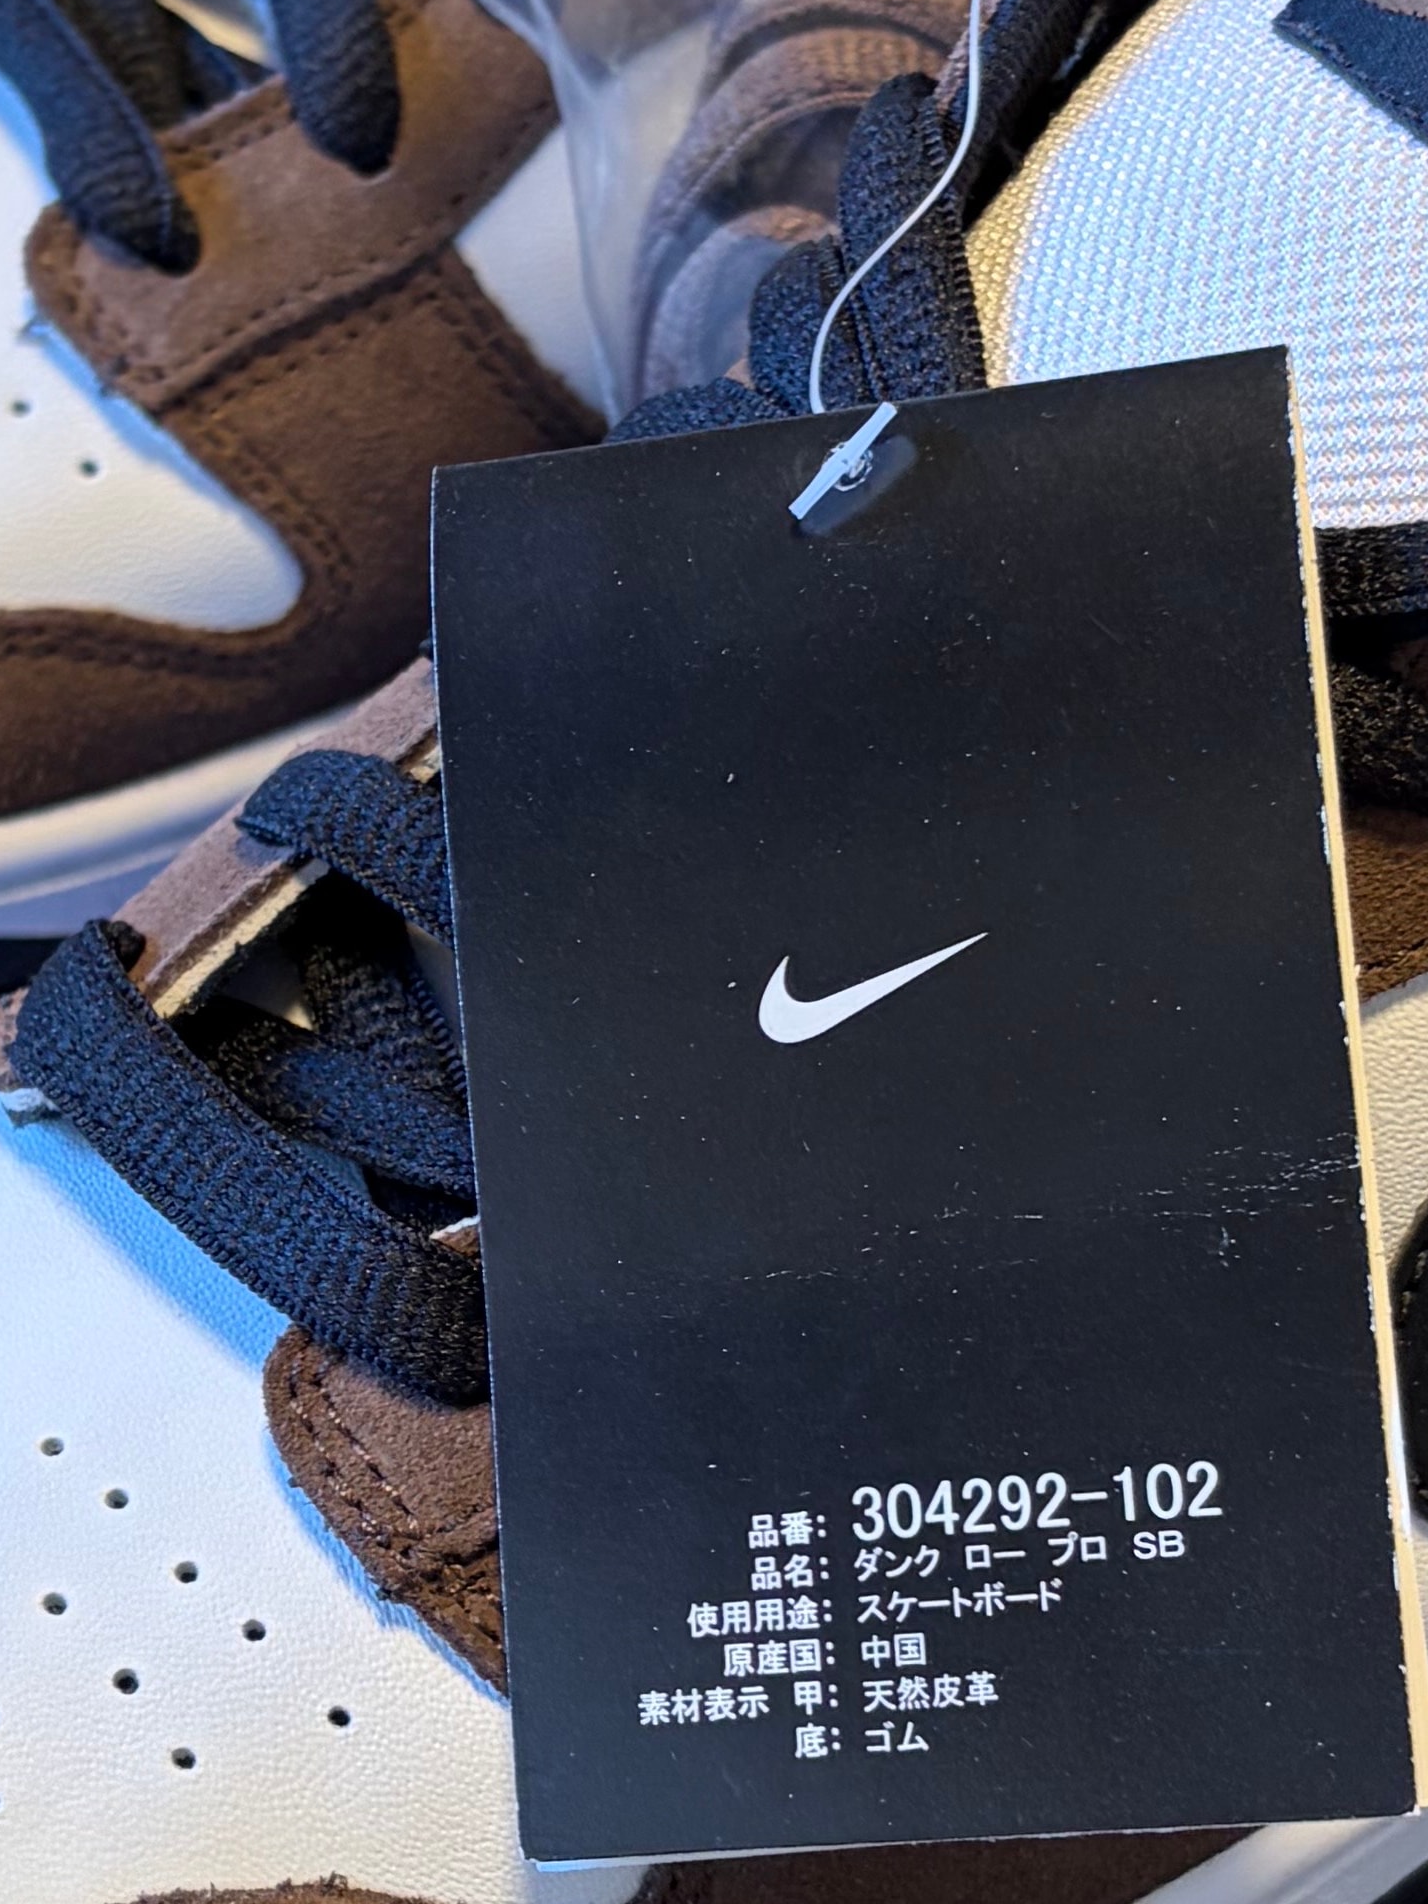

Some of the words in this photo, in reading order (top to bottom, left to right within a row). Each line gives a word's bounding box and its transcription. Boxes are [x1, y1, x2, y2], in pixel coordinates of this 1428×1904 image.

[851, 1460, 1224, 1542] 304292-102
[853, 1546, 941, 1582] ダンク
[964, 1543, 1027, 1571] ロー
[1047, 1530, 1108, 1567] プロ
[1133, 1529, 1186, 1560] SB
[856, 1577, 1063, 1624] スケートボード
[860, 1632, 927, 1669] 中国
[637, 1685, 771, 1726] 素材表示
[862, 1670, 1000, 1713] 天然皮革
[864, 1720, 930, 1753] ゴム
